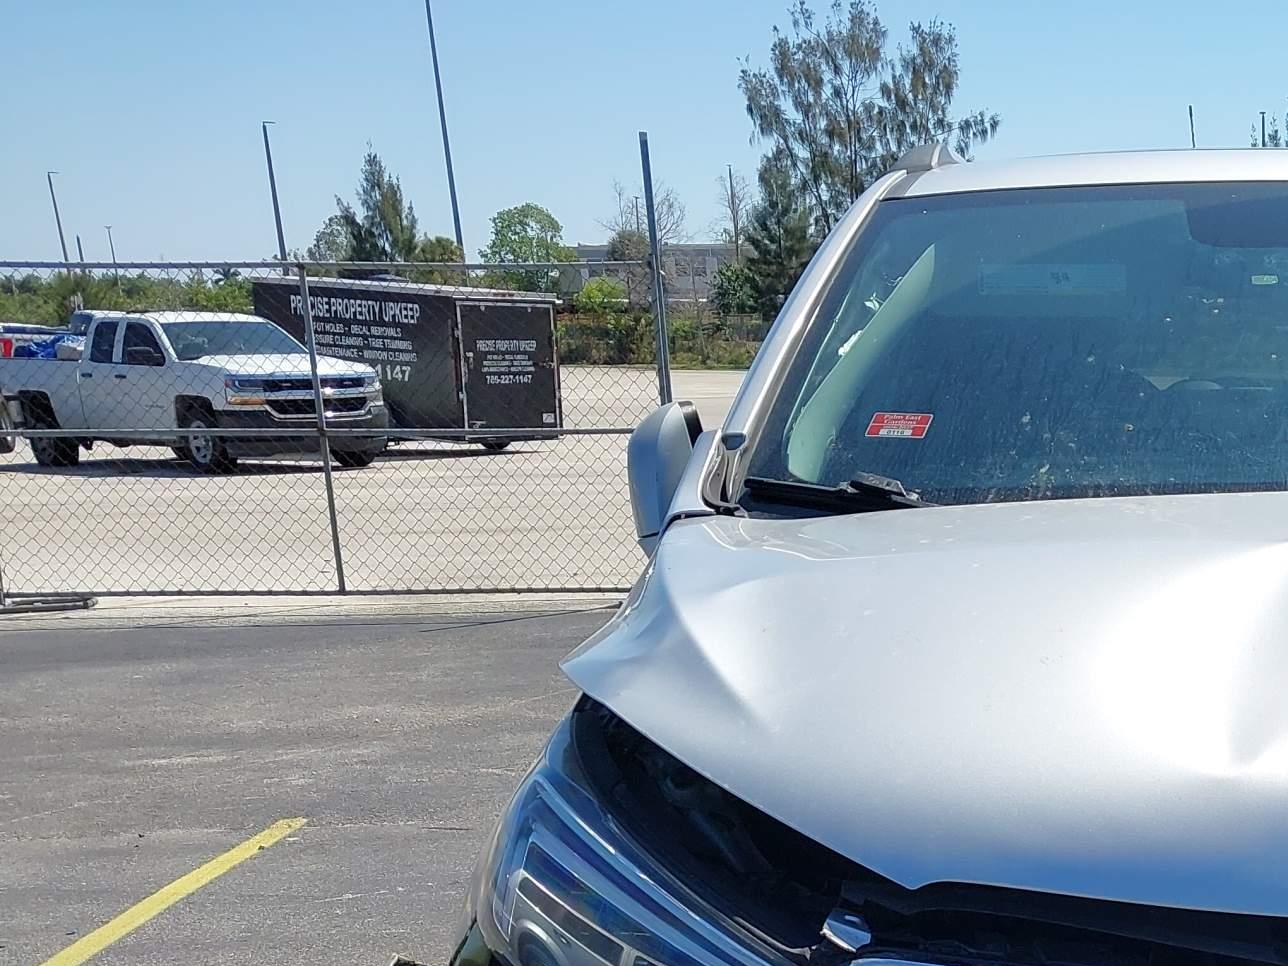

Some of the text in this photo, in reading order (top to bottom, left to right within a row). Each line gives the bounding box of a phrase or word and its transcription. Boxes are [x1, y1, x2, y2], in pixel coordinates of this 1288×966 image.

[290, 295, 420, 324] PRCISE PROPERTY UPKEEP
